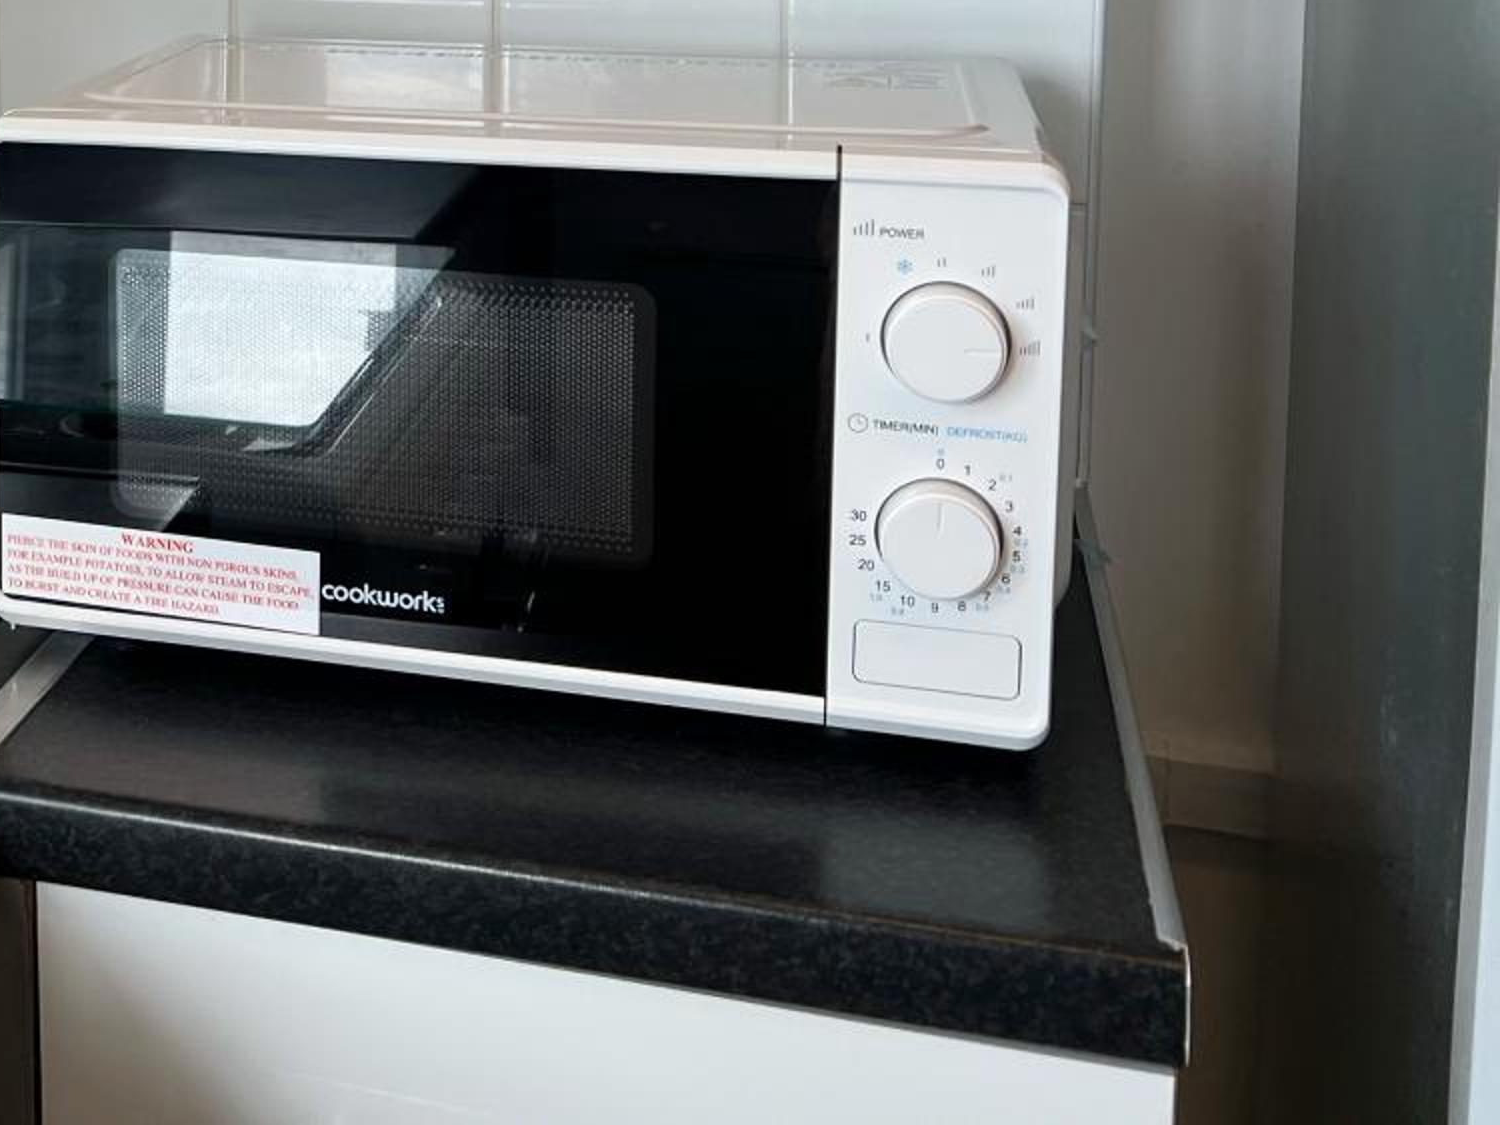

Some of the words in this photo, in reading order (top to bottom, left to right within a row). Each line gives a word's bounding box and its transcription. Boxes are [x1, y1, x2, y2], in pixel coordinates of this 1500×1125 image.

[879, 226, 924, 239] POWER
[935, 458, 945, 470] 0
[963, 464, 971, 475] 1
[988, 479, 997, 491] 2
[1004, 500, 1014, 513] 3
[851, 509, 867, 522] 30
[1012, 525, 1022, 537] 4
[121, 532, 194, 553] WARNING
[848, 534, 867, 546] 25
[72, 542, 97, 554] SKIN
[155, 553, 185, 566] WITH
[187, 557, 212, 569] NON
[1012, 550, 1021, 563] 5
[857, 558, 875, 572] 20
[8, 577, 23, 588] TO
[1001, 571, 1011, 584] 6
[875, 579, 891, 593] 15
[321, 582, 445, 614] cookworks
[899, 595, 915, 608] 10
[930, 601, 939, 613] 9
[957, 600, 967, 612] 8
